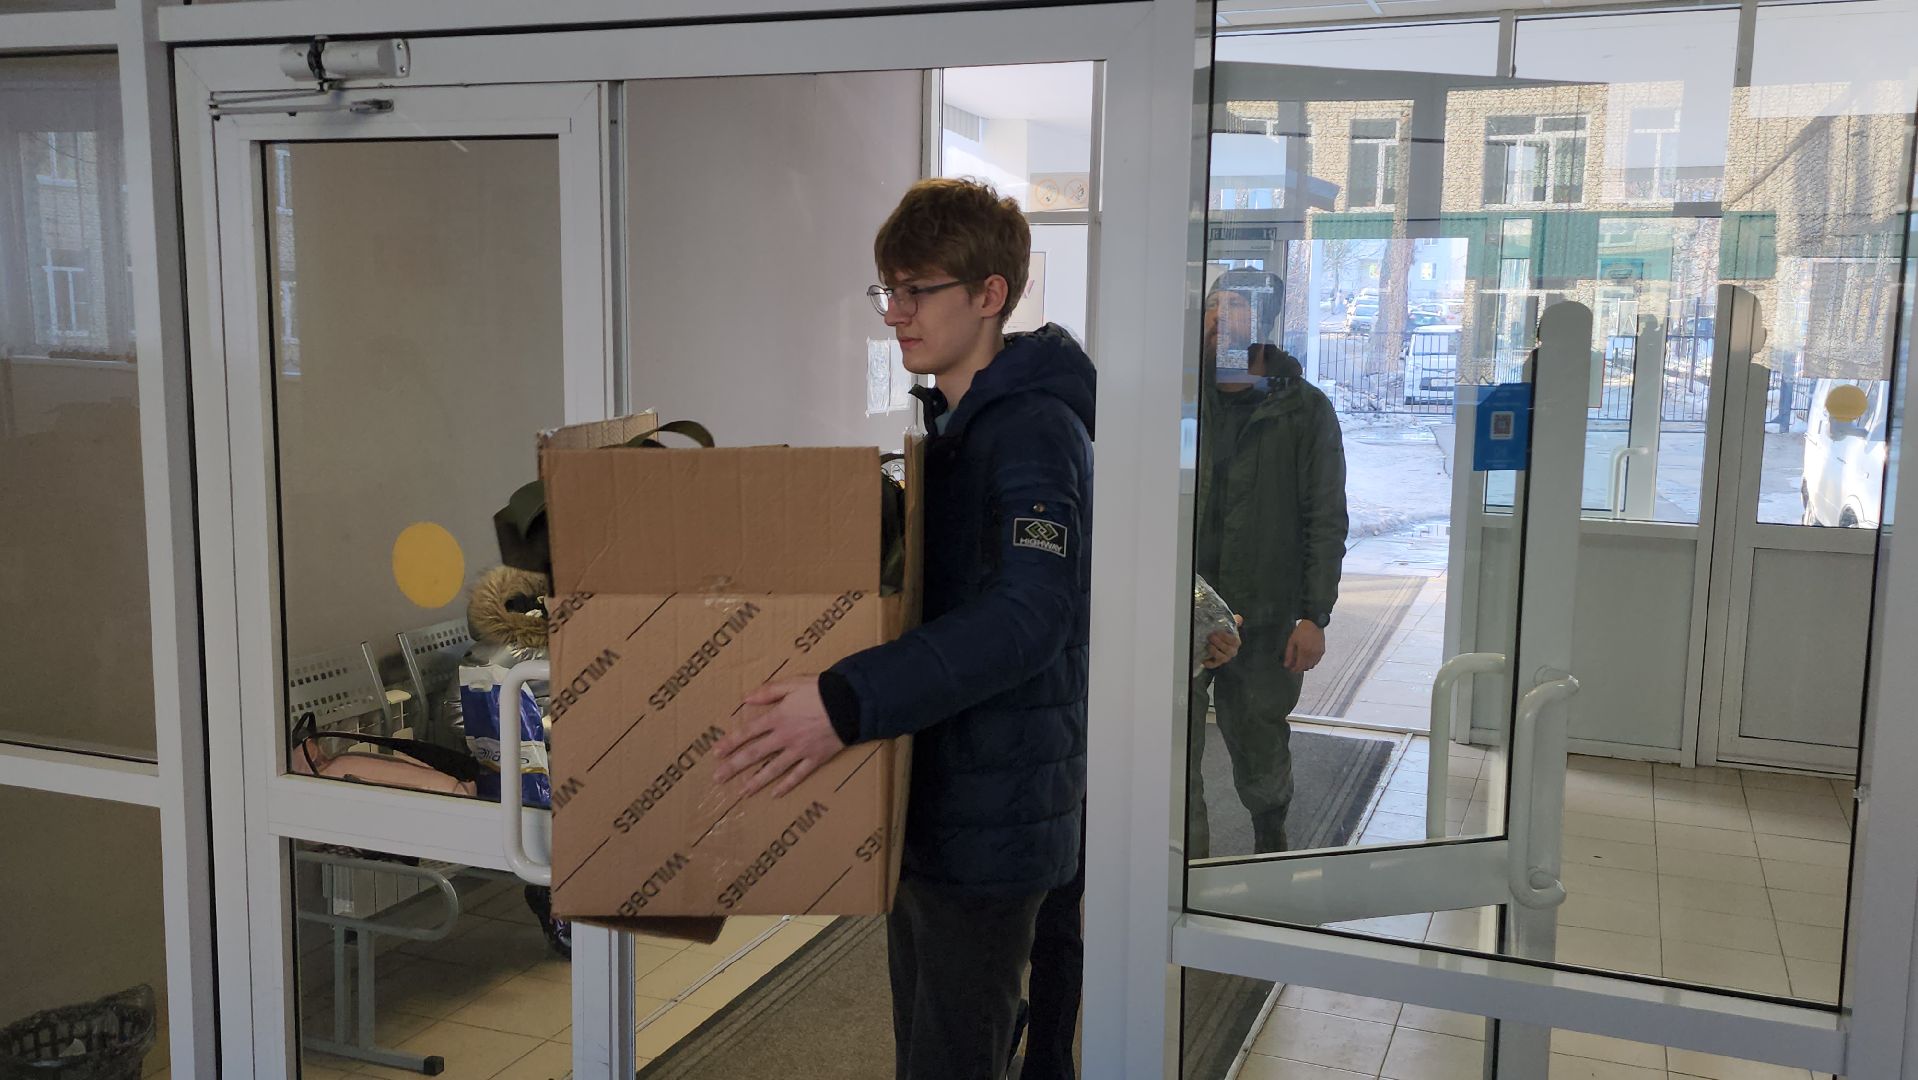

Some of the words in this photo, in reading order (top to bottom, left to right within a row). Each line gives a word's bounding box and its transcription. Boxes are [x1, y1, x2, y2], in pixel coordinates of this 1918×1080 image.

[1020, 537, 1062, 553] HIGHWAY
[649, 602, 761, 711] WILDBERRIES
[613, 725, 726, 834] WILDBERRIES
[717, 801, 829, 909] WILDBERRIES
